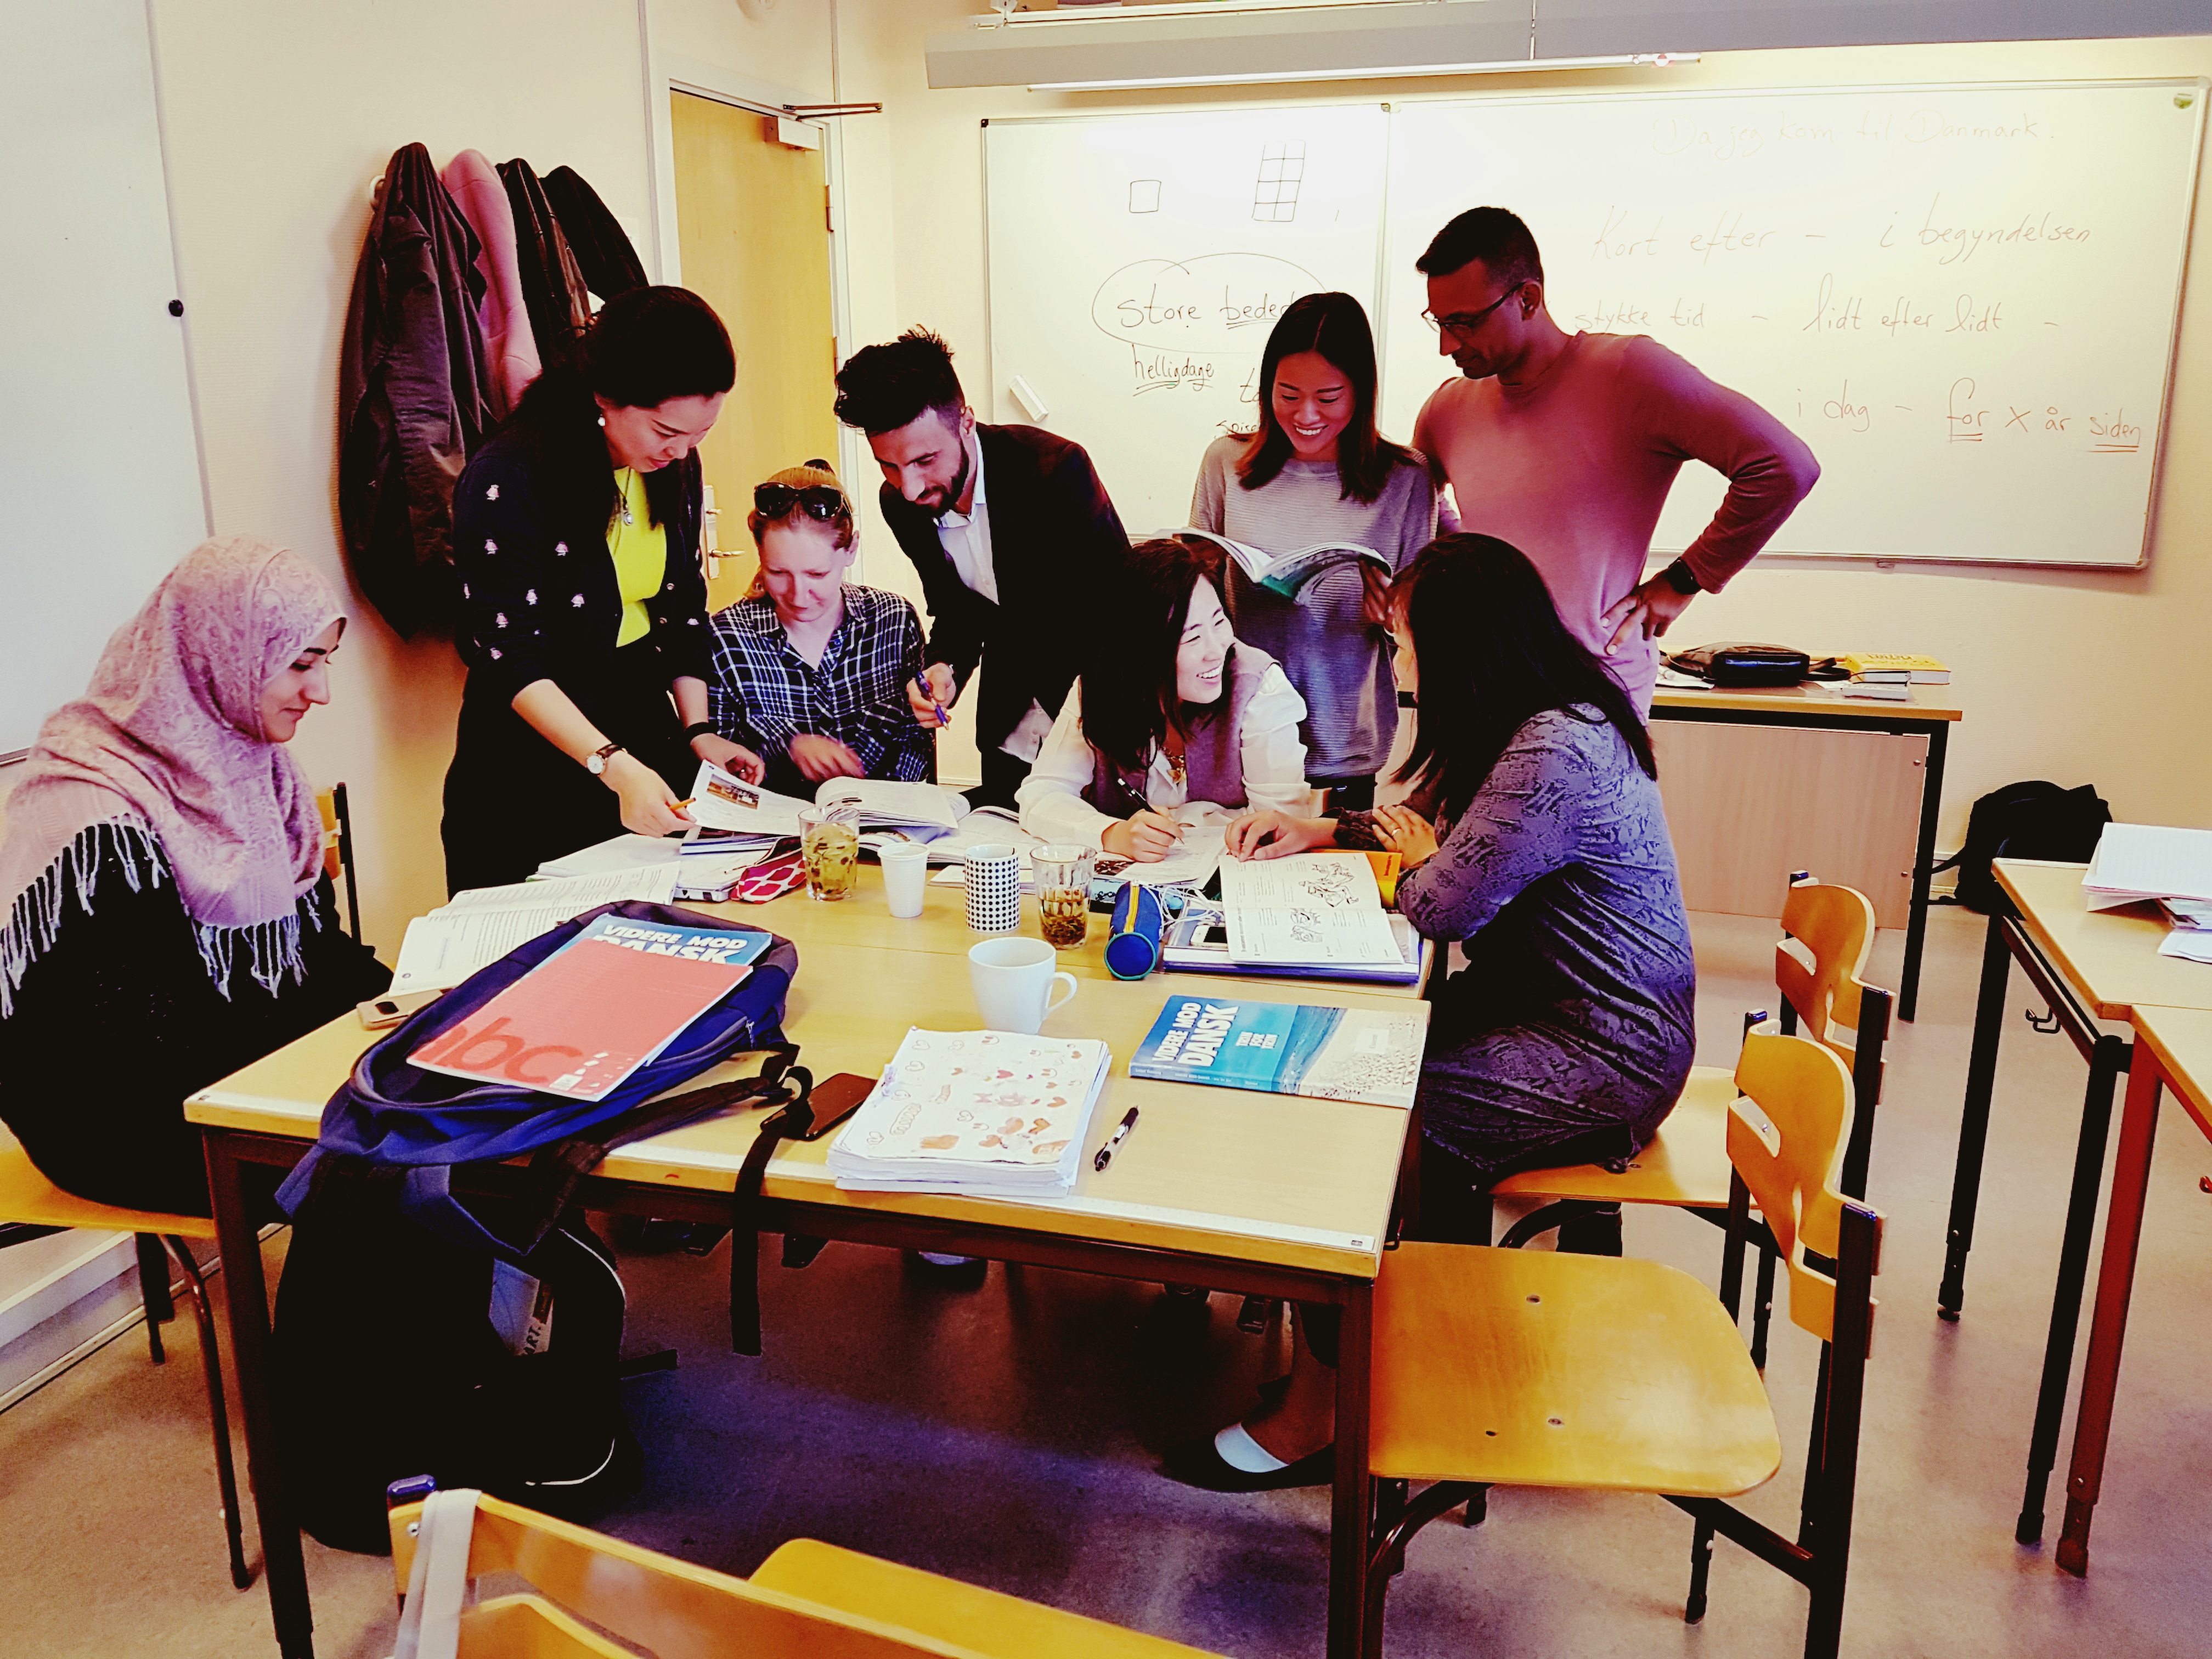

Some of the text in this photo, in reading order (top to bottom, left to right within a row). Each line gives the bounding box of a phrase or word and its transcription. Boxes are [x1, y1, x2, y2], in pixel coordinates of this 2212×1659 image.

[1651, 109, 2055, 161] Da jeg kom til Danmark.
[1590, 204, 1664, 261] Kort
[1689, 210, 1777, 266] efter
[1879, 210, 1899, 249] i
[1917, 191, 2091, 266] begyndelsen
[1575, 300, 1651, 332] stykke
[1669, 297, 1705, 328] tid
[1802, 272, 1863, 333] lidt
[1881, 295, 1934, 337] efter
[1944, 294, 2002, 333] lidt
[1823, 378, 1871, 433] dag
[1946, 377, 1990, 443] for
[2045, 405, 2072, 432] år
[2089, 407, 2141, 445] siden
[603, 924, 748, 949] VIDERE MOD
[1152, 1002, 1201, 1062] VIDERE MOD
[1177, 1003, 1239, 1067] DANSK
